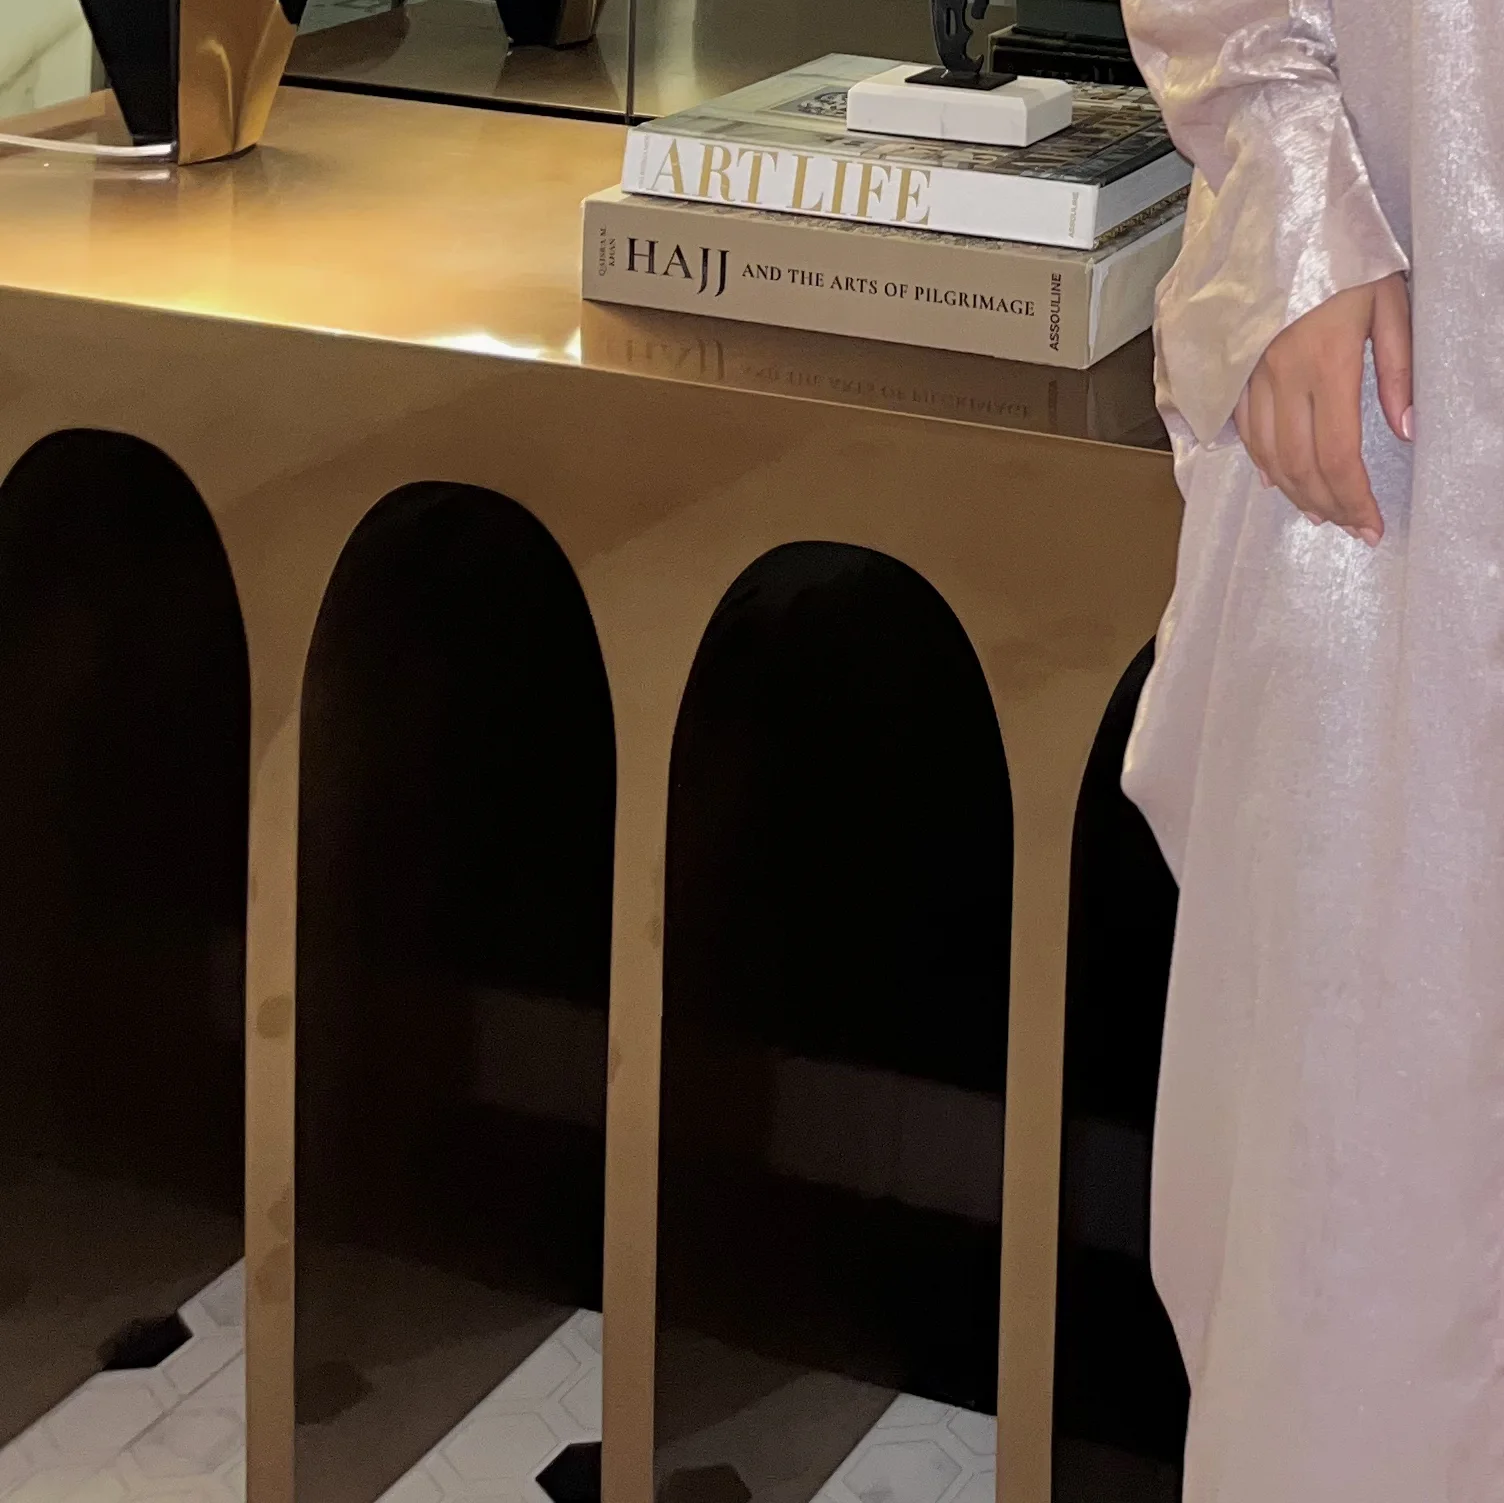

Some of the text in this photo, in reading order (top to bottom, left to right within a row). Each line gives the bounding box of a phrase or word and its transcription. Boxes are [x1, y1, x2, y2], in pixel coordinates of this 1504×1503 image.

[646, 138, 779, 205] ART
[785, 154, 931, 225] LIFE
[1068, 191, 1079, 238] ASSOULINE
[627, 237, 1035, 317] HAJJ AND THE ARTS OF PILGRIMAGE
[1049, 272, 1061, 351] ASSOULINE
